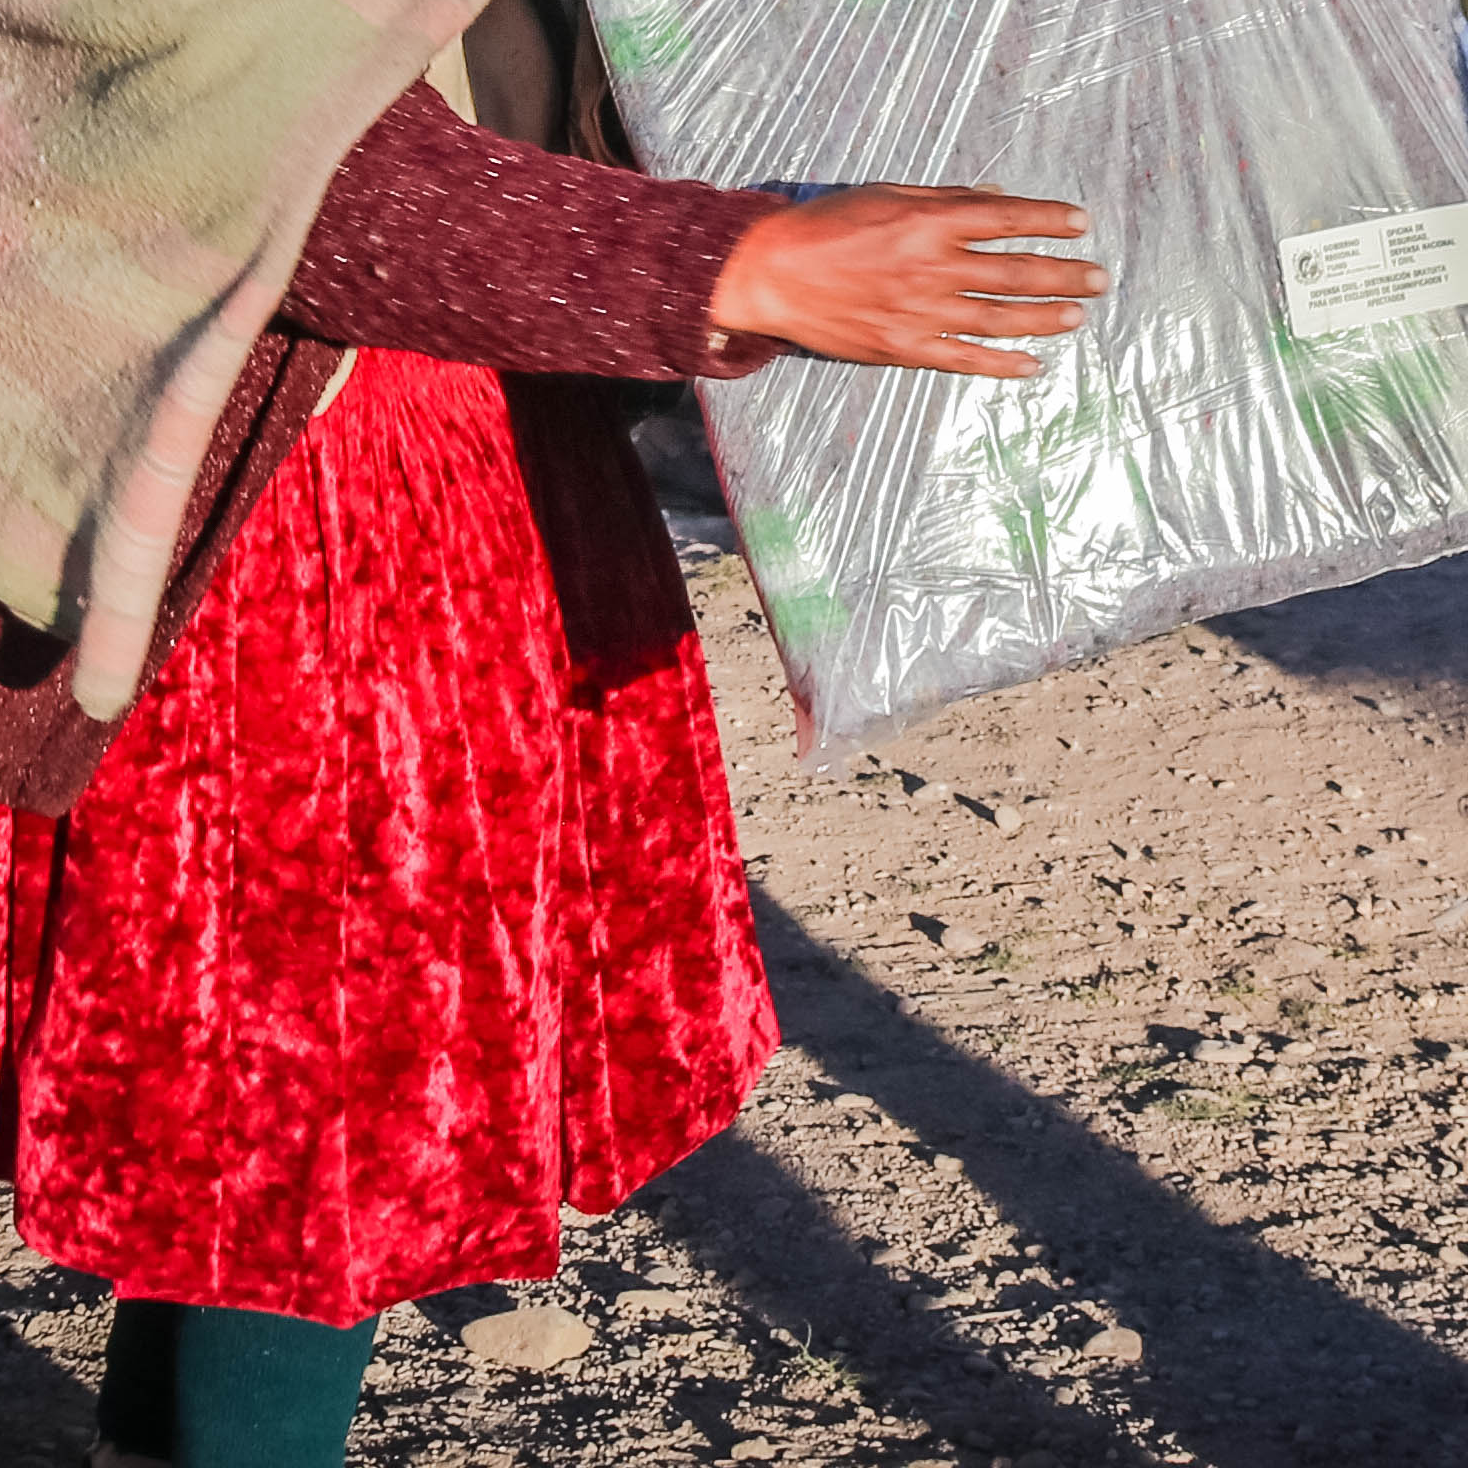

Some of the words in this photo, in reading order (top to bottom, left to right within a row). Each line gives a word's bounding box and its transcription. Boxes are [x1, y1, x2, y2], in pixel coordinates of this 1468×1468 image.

[1415, 223, 1424, 232] DE
[1389, 244, 1420, 257] DEFENSA
[1423, 239, 1455, 249] NACIONAL
